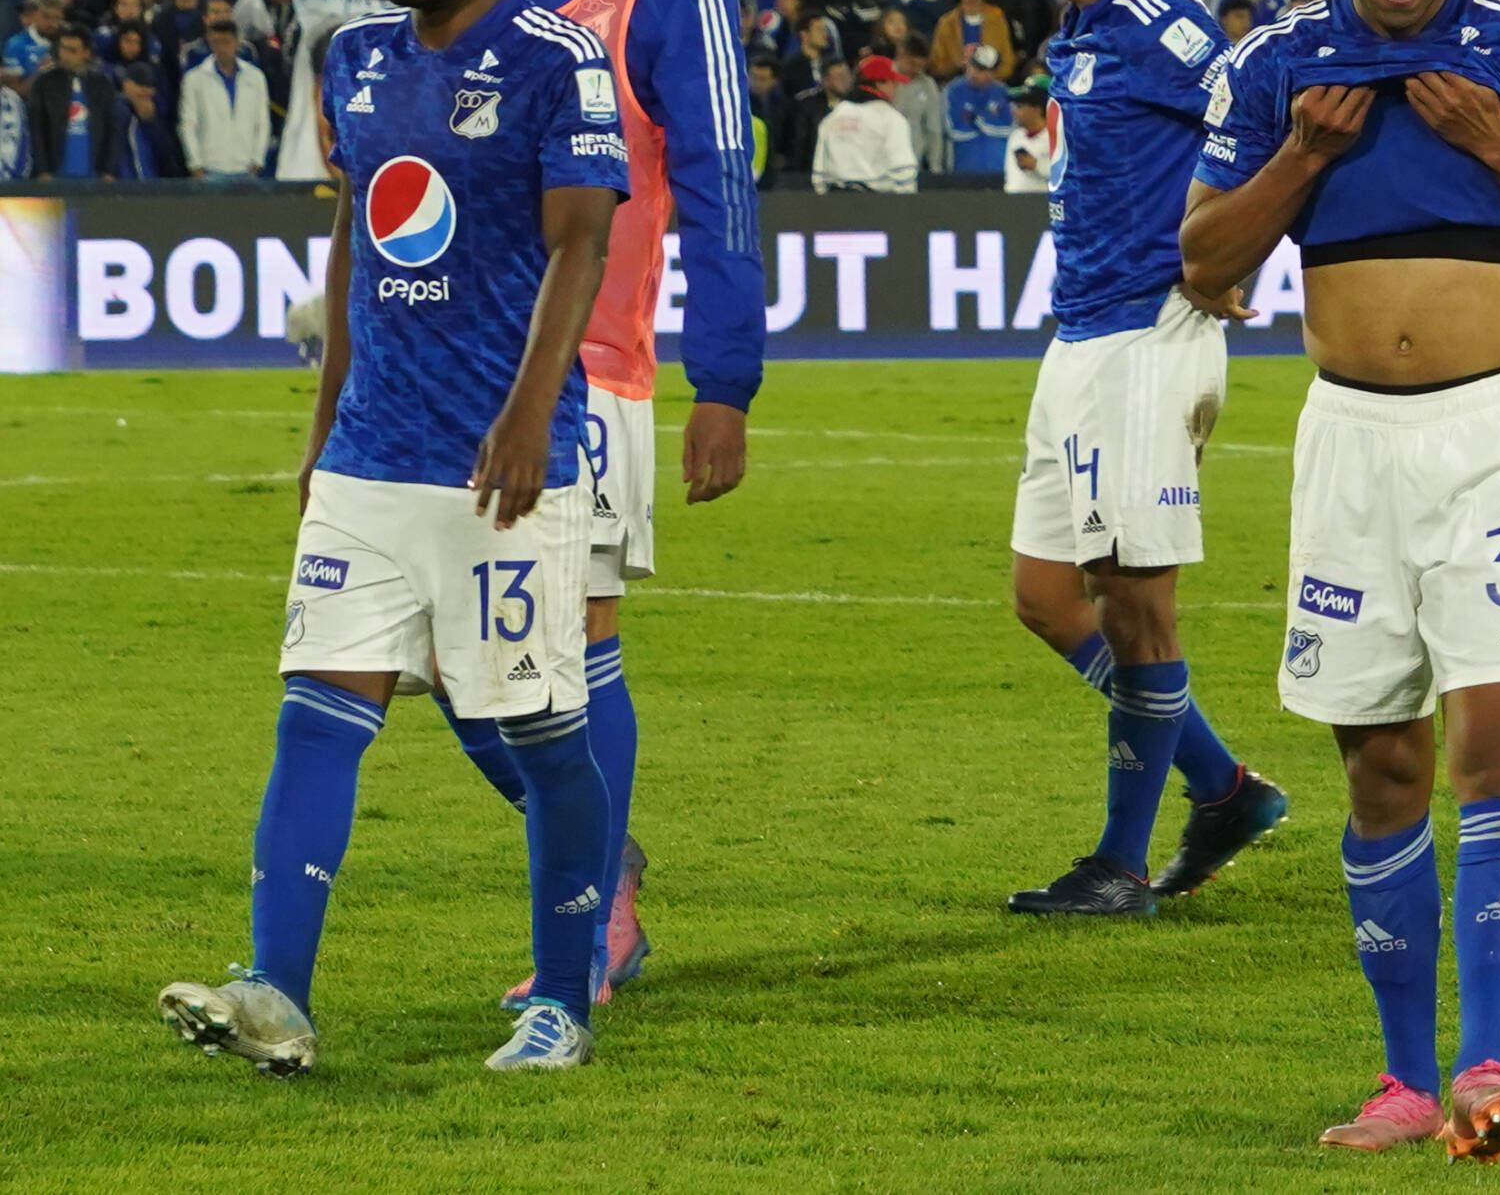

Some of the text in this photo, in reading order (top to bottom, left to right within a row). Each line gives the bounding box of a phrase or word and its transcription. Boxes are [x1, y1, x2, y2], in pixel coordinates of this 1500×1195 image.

[378, 275, 450, 307] pepsi
[1063, 433, 1100, 501] 14
[472, 560, 538, 642] 13
